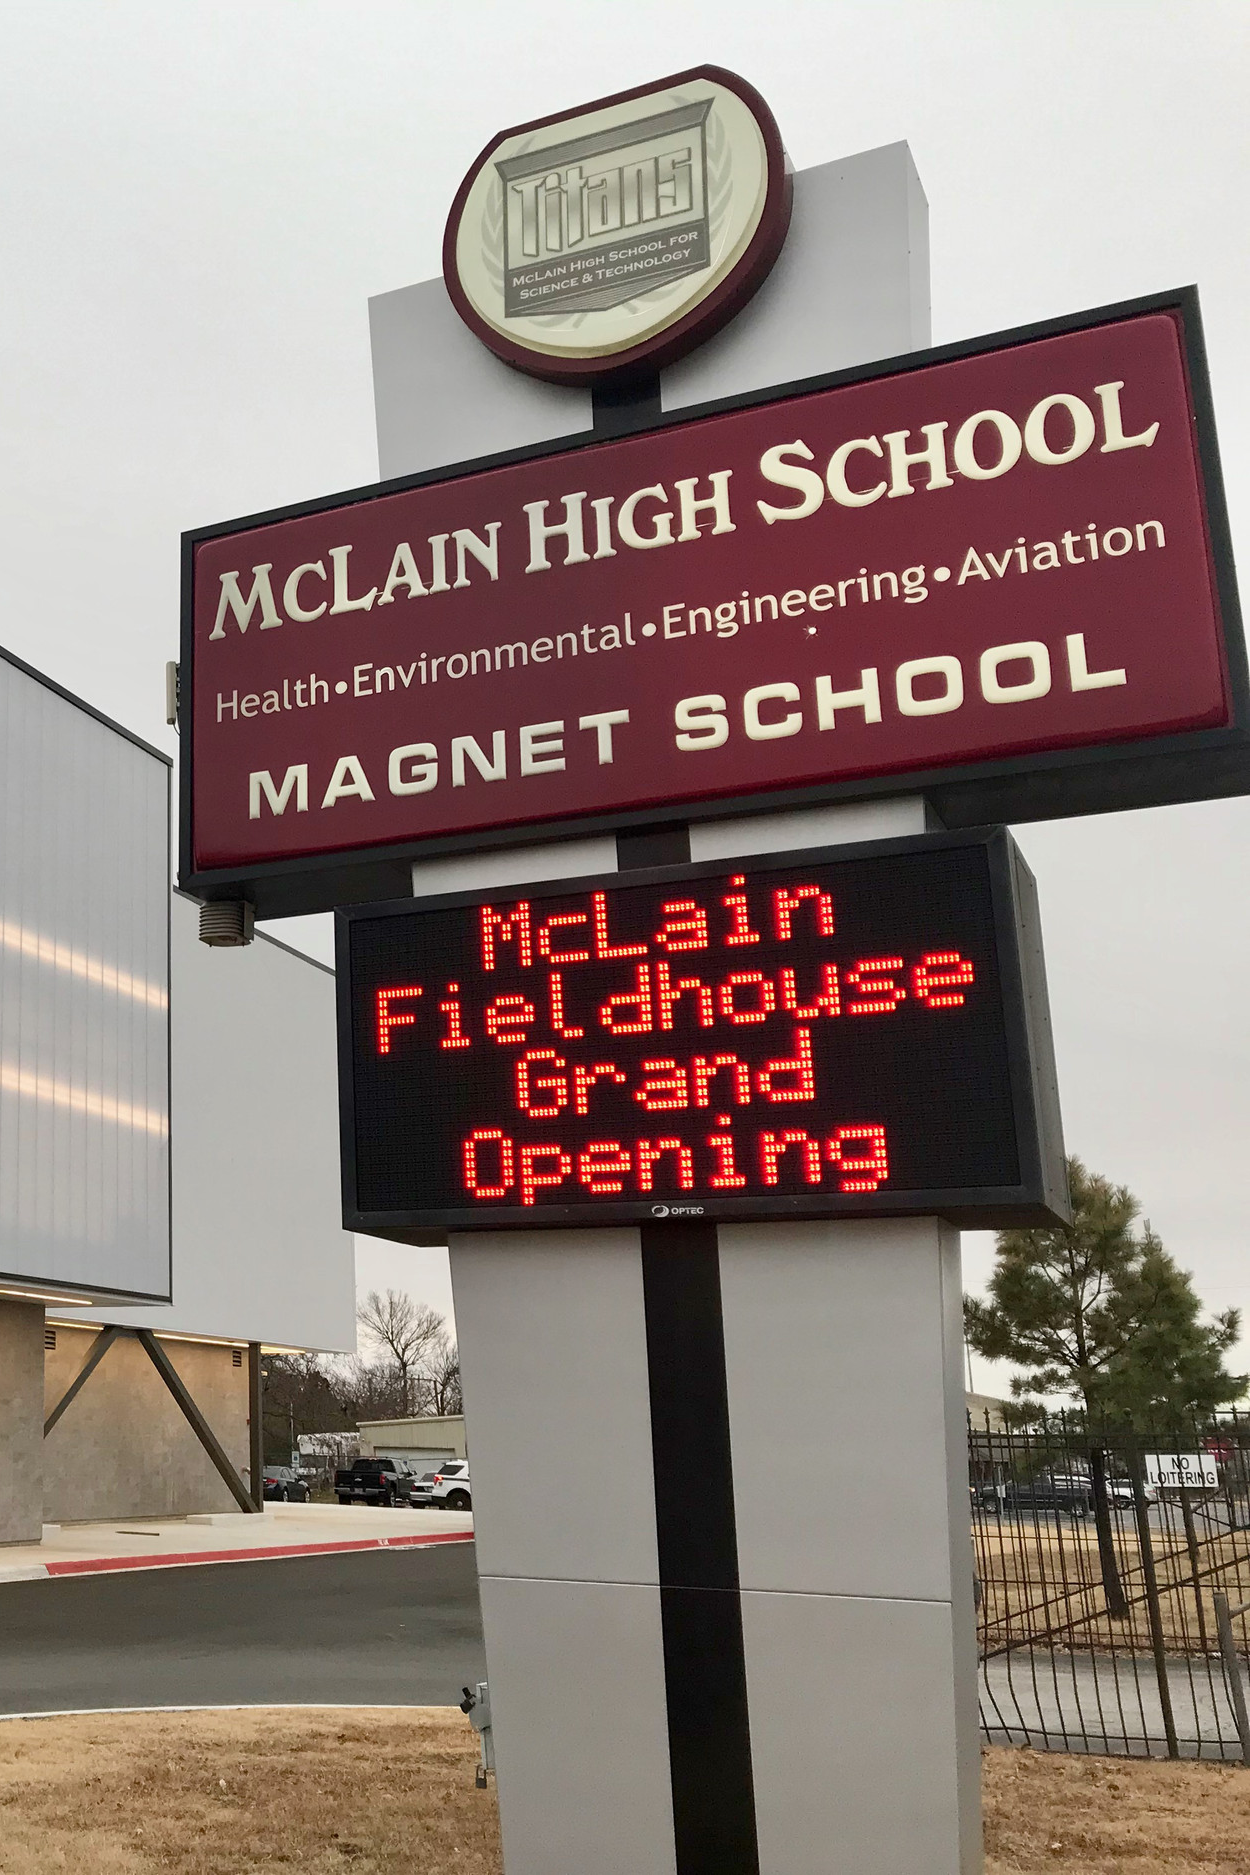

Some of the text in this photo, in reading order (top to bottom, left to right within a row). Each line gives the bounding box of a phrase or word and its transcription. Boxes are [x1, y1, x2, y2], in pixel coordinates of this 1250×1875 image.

[511, 147, 694, 258] Titans
[519, 248, 691, 300] SCIENCE & TECHNOLOGY
[570, 255, 605, 272] HIGH
[608, 240, 667, 262] SCHOOL
[670, 231, 699, 247] FOR
[523, 469, 737, 574] HIGH
[756, 380, 1160, 525] SCHOOL
[249, 632, 1127, 820] MAGNET SCHOOL
[480, 874, 834, 971] McLain
[375, 950, 975, 1055] Fieldhouse
[515, 1027, 816, 1118] Grand
[463, 1114, 889, 1206] Opening
[671, 1207, 704, 1215] OPTEC
[1150, 1471, 1216, 1485] LOITERING
[1171, 1457, 1190, 1470] NO
